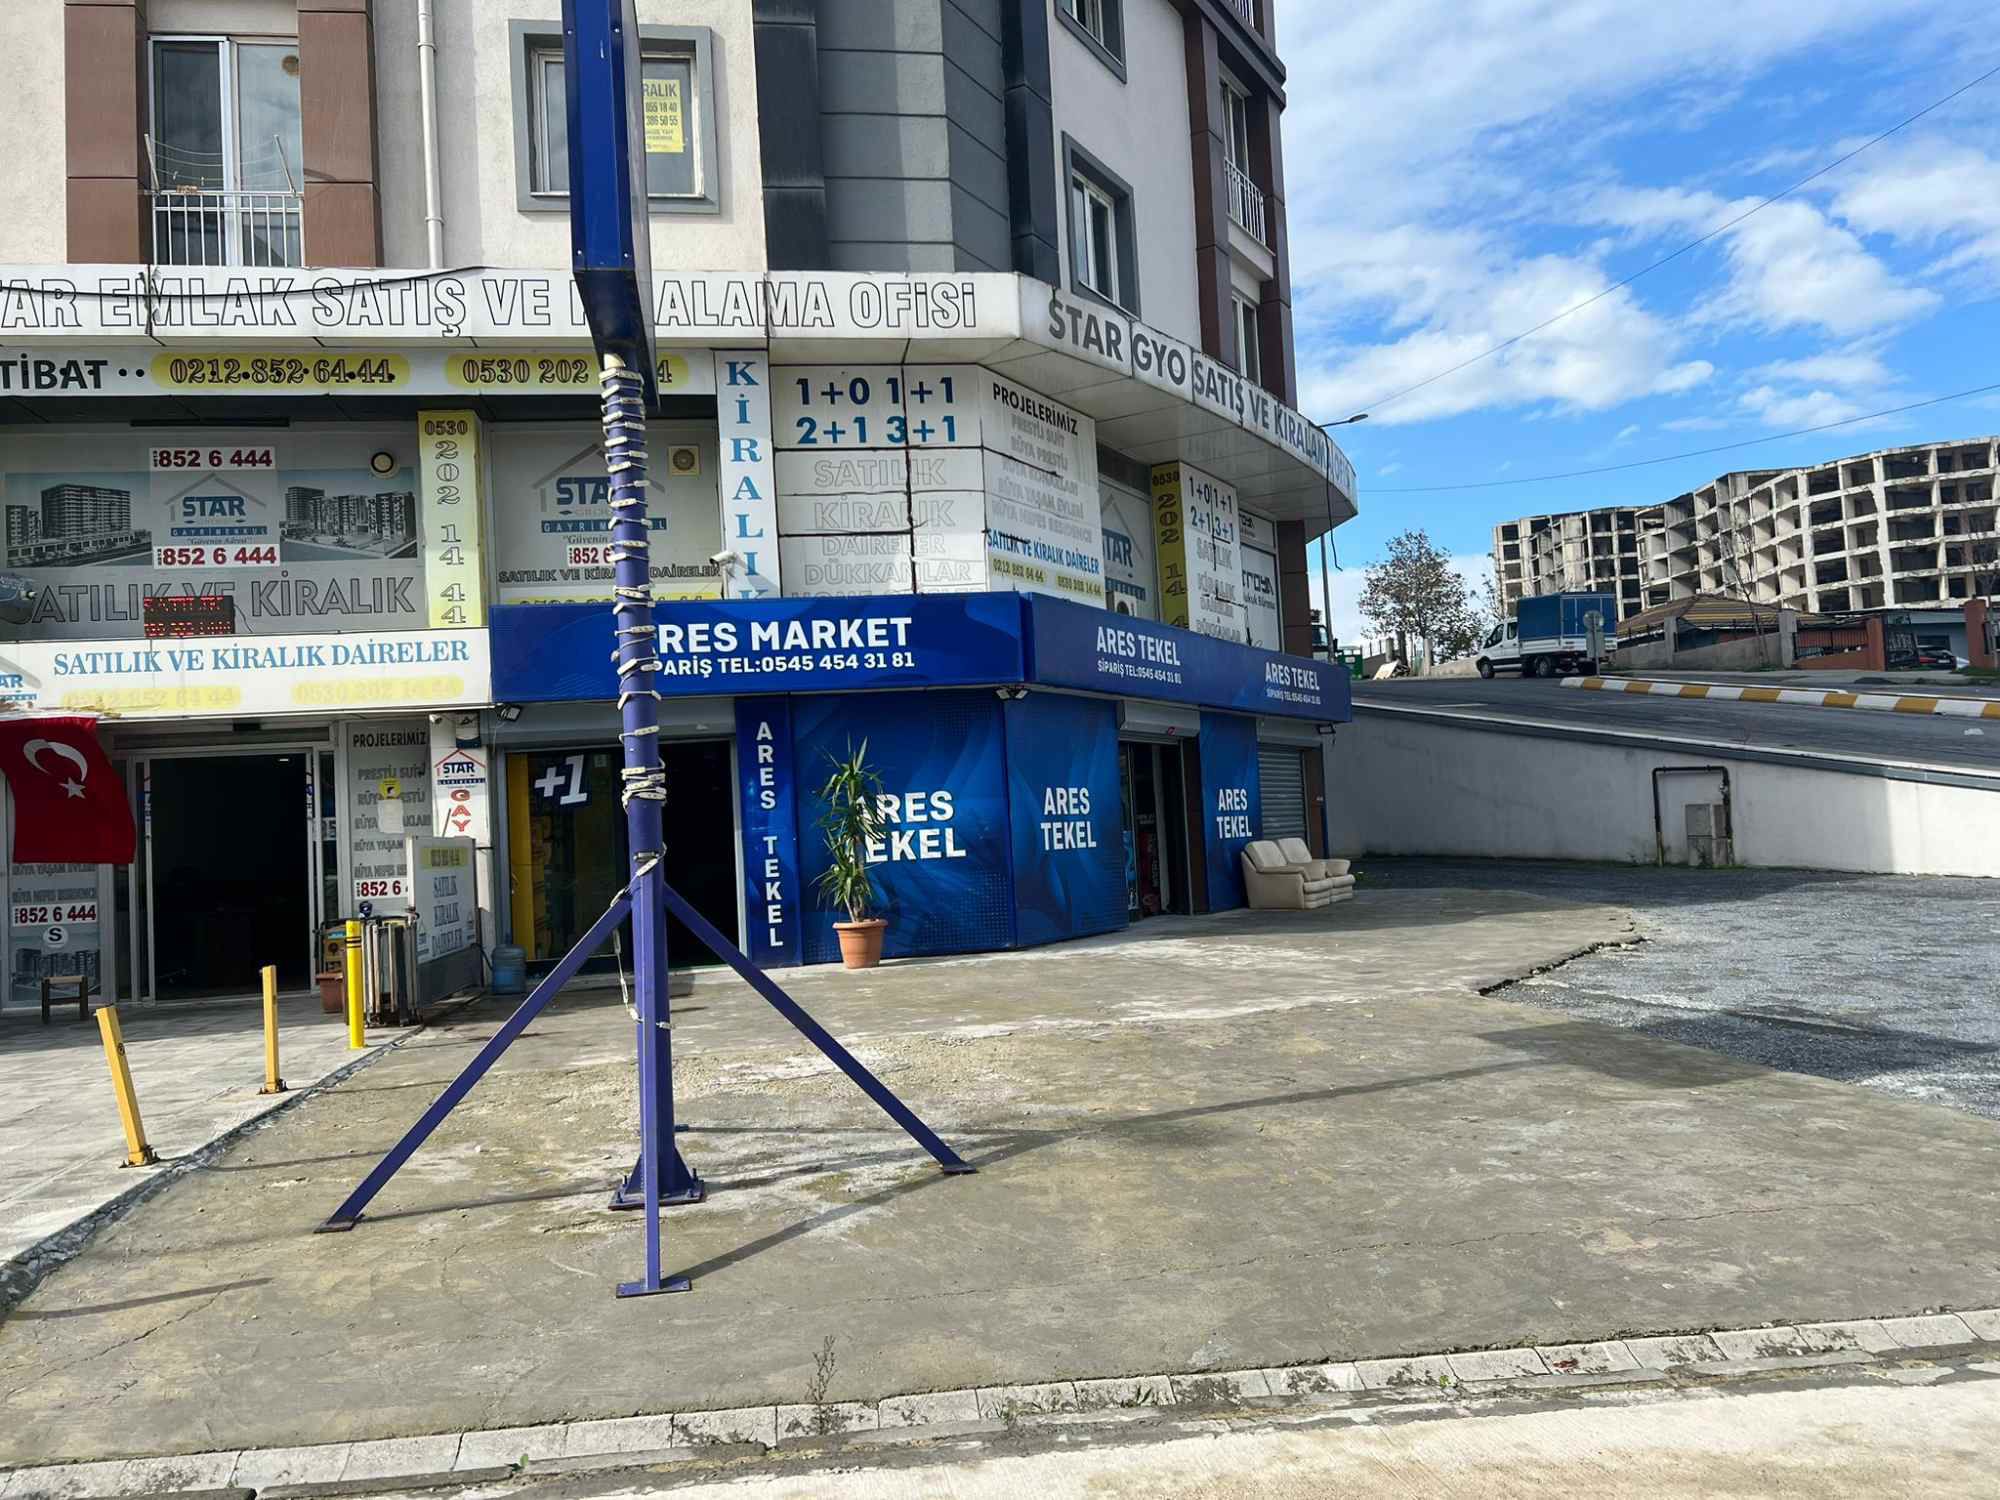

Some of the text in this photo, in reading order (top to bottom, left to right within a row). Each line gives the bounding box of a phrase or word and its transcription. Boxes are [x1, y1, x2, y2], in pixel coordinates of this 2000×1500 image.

[642, 83, 677, 97] RALIK
[0, 278, 82, 328] AR
[100, 277, 295, 327] EMLAK
[311, 276, 467, 337] SATIŞ
[482, 279, 551, 326] VE
[570, 279, 835, 328] ALAMA
[462, 359, 531, 384] 0530
[538, 359, 589, 384] 202
[1049, 301, 1124, 362] STAR
[1132, 332, 1187, 386] GYO
[1193, 357, 1245, 429] SATIŞ
[1248, 387, 1270, 430] VE
[796, 376, 953, 405] 1+0 1+1
[993, 382, 1078, 436] PROJELERİMİZ
[424, 421, 468, 435] 0530
[796, 415, 956, 444] 2+1 3+1
[159, 450, 201, 467] 852
[208, 450, 222, 467] 6
[230, 450, 273, 467] 444
[434, 440, 461, 505] 202
[814, 458, 947, 487] SATILIK
[556, 477, 612, 505] STA
[1189, 476, 1233, 514] 1+0 1+1
[182, 495, 246, 517] STAR
[814, 495, 956, 530] KİRALIK
[1191, 506, 1211, 535] 2+1
[1215, 516, 1234, 542] 3+1
[162, 547, 277, 565] 852 6 444
[573, 547, 599, 564] 852
[1103, 527, 1134, 568] TAR
[499, 567, 558, 583] SATILIK
[558, 567, 580, 581] VE
[32, 582, 170, 623] ATILI
[251, 570, 416, 617] KİRALIK
[655, 617, 913, 654] RES MARKET
[1096, 626, 1181, 666] ARES TEKEL
[54, 638, 470, 676] SATILIK VE KİRALIK DAİRELER
[717, 655, 814, 674] TEL:0545
[820, 655, 858, 671] 454
[865, 653, 887, 669] 31
[892, 652, 915, 668] 81
[0, 674, 24, 688] AR
[1265, 661, 1320, 691] ARES TEKEL
[352, 730, 427, 748] PROJELERİMİZ
[443, 762, 475, 773] STAR
[534, 754, 588, 805] +1
[756, 721, 776, 810] ARES
[450, 789, 471, 836] GAY
[1043, 787, 1090, 815] ARES
[1218, 788, 1248, 811] ARES
[1040, 821, 1097, 851] TEKEL
[1216, 815, 1252, 840] TEKEL
[865, 827, 967, 863] EKEL
[361, 879, 401, 897] 852 6
[762, 835, 783, 948] TEKEL
[20, 905, 96, 923] 852 6 444
[48, 928, 62, 941] S
